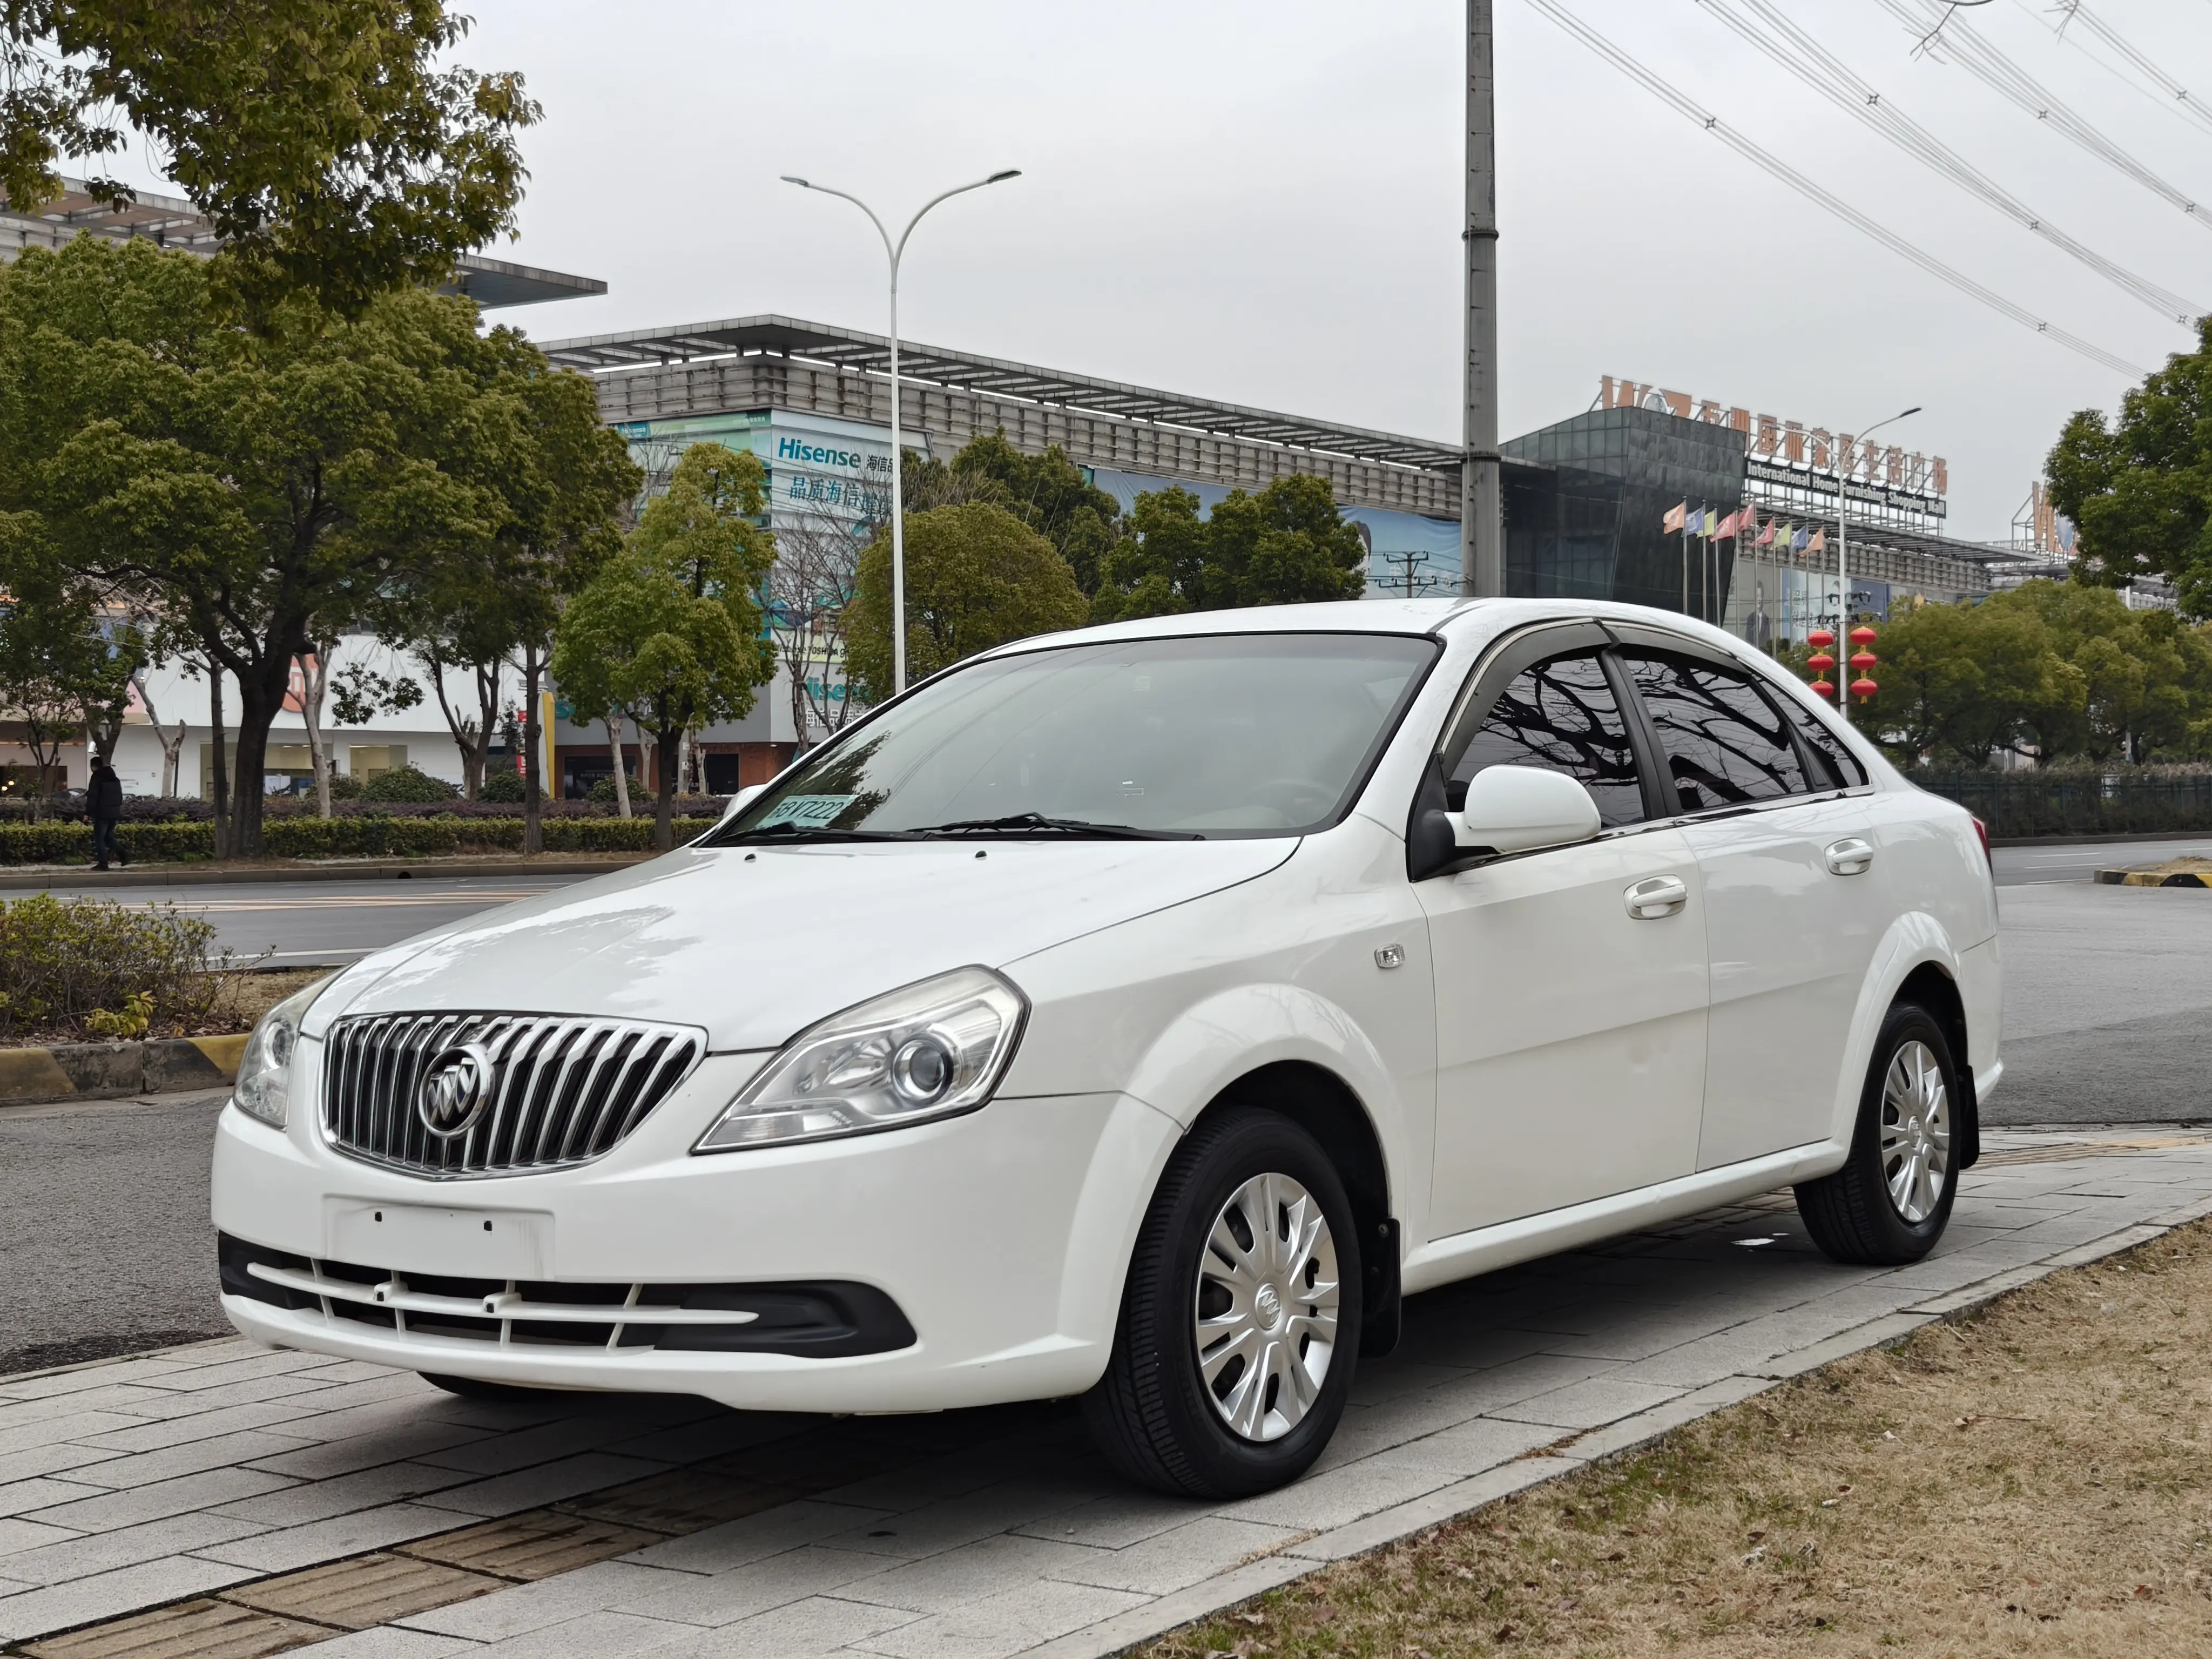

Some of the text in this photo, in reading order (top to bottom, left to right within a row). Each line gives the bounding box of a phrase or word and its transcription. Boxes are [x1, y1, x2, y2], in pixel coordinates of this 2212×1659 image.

[778, 437, 861, 469] Hisense
[1747, 461, 1810, 487] International
[1813, 475, 1838, 493] Home
[1888, 492, 1926, 514] Shopping
[1927, 501, 1946, 514] Mall
